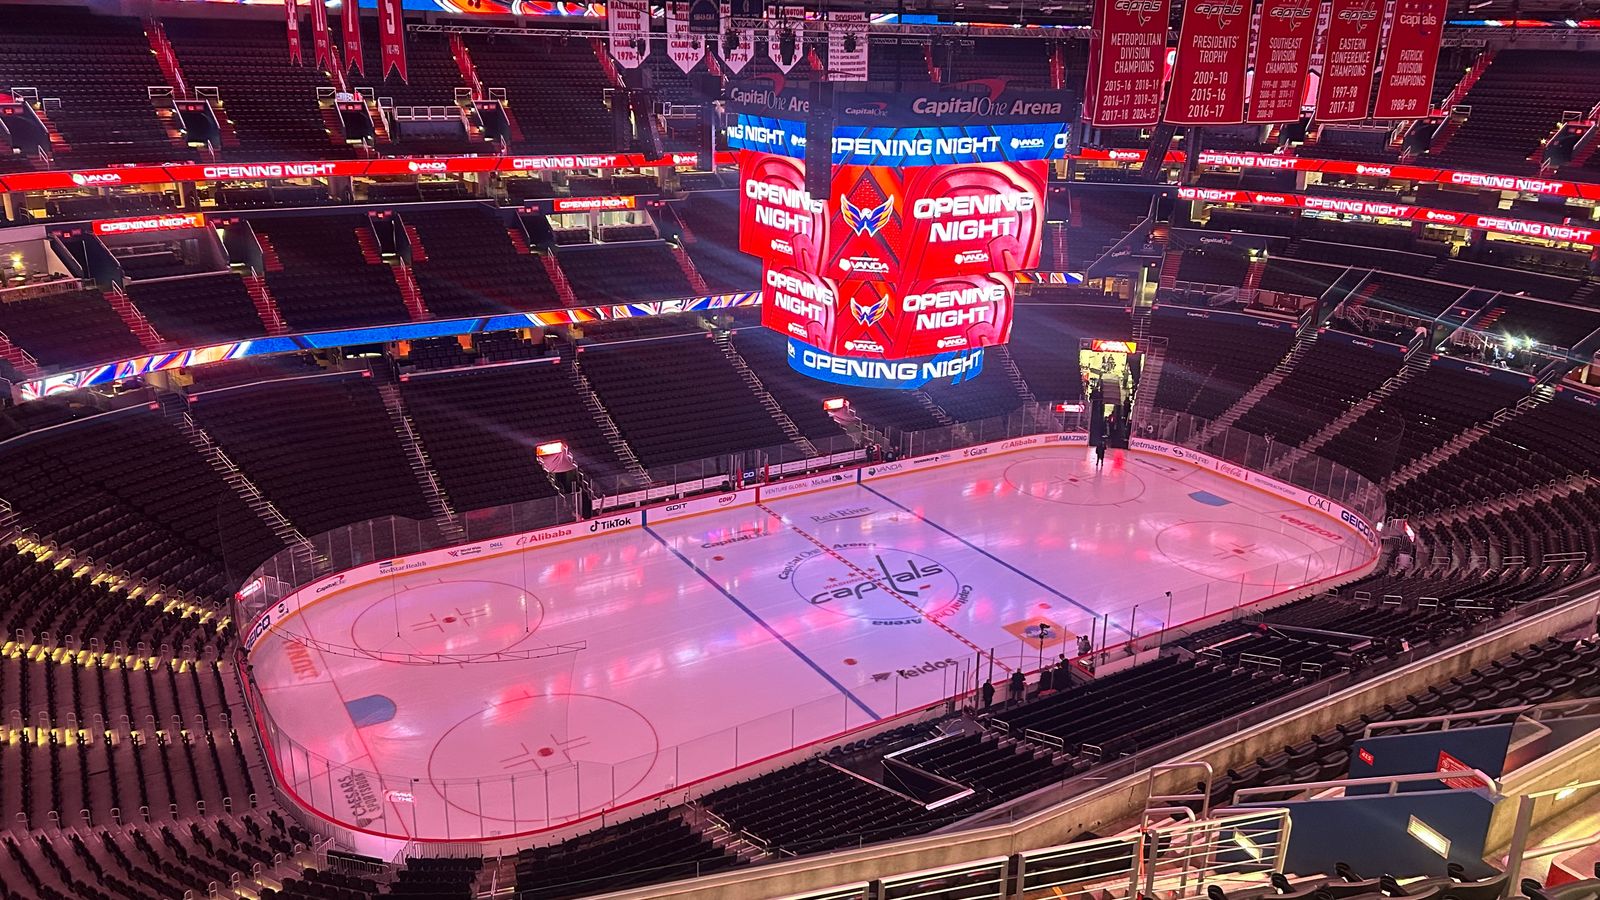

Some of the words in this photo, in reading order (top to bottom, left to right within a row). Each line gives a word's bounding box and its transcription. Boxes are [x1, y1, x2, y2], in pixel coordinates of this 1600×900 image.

[610, 2, 646, 10] BALTIMORE
[617, 11, 640, 19] BULLETS
[1111, 33, 1162, 46] METROPOLITAN
[1269, 37, 1303, 49] SOUTHEAST
[1339, 38, 1367, 50] EASTERN
[1120, 47, 1151, 59] DIVISION
[1199, 50, 1228, 63] TROPHY
[1271, 50, 1296, 61] DIVISION
[1330, 51, 1370, 64] CONFERENCE
[1399, 50, 1423, 61] PATRICK
[1114, 61, 1155, 73] CHAMPIONS
[1265, 62, 1298, 74] CHAMPIONS
[1330, 65, 1367, 77] CHAMPIONS
[1396, 63, 1423, 74] DIVISION
[1193, 72, 1228, 85] 2009-10
[1390, 75, 1426, 86] CHAMPIONS
[1104, 80, 1131, 91] 2015-16
[1135, 79, 1159, 90] 2018-19
[1190, 88, 1226, 101] 2015-16
[1332, 86, 1358, 98] 1997-98
[788, 96, 810, 113] Are
[1103, 94, 1130, 106] 2016-17
[1390, 99, 1417, 110] 1988-89
[1010, 100, 1061, 116] Arena
[1187, 105, 1225, 117] 2016-17
[1328, 101, 1355, 114] 2017-18
[1101, 109, 1129, 120] 2017-18
[744, 126, 785, 146] NIGHT
[936, 137, 1001, 154] NIGHT
[1020, 138, 1044, 147] VANDA
[417, 162, 447, 170] VANDA
[513, 158, 574, 168] OPENING
[576, 156, 616, 168] NIGHT
[1198, 153, 1254, 165] OPENING
[1256, 158, 1297, 168] NIGHT
[204, 166, 282, 178] OPENING
[285, 163, 336, 176] NIGHT
[84, 173, 121, 182] VANDA
[1452, 172, 1514, 188] OPENING
[1515, 179, 1563, 193] NIGHT
[745, 179, 823, 214] OPENING
[1197, 189, 1236, 200] NIGHT
[1262, 195, 1284, 203] VANDA
[559, 200, 599, 209] OPENING
[601, 198, 630, 208] NIGHT
[913, 192, 1034, 219] OPENING
[1304, 198, 1363, 212] OPENING
[1365, 204, 1408, 216] NIGHT
[755, 204, 811, 235] NIGHT
[1435, 213, 1456, 221] VANDA
[100, 219, 157, 232] OPENING
[158, 216, 197, 229] NIGHT
[929, 217, 1015, 242] NIGHT
[1477, 216, 1542, 235] OPENING
[1543, 226, 1591, 241] NIGHT
[962, 253, 989, 261] VANDA
[851, 261, 889, 270] VANDA
[766, 270, 834, 307] OPENING
[903, 285, 1005, 312] OPENING
[775, 291, 822, 321] NIGHT
[916, 306, 990, 331] NIGHT
[853, 343, 884, 351] VANDA
[944, 337, 967, 346] VANDA
[803, 350, 917, 380] OPENING
[922, 351, 982, 379] NIGHT
[1009, 437, 1037, 448] Alibaba
[969, 447, 988, 456] Giant
[875, 463, 903, 474] VANDA
[811, 477, 832, 487] Michael
[764, 486, 787, 495] VENTURE
[788, 482, 807, 490] GLOBAL
[718, 495, 733, 503] CDW
[1307, 494, 1332, 512] CACI
[665, 502, 687, 511] GDIT
[810, 512, 838, 523] Red
[839, 505, 873, 518] River
[601, 517, 631, 529] TikTok
[1280, 514, 1343, 541] verizon
[1340, 510, 1370, 537] GEICO
[529, 528, 572, 543] Alibaba
[379, 565, 405, 576] MedStar
[405, 560, 427, 571] Health
[810, 554, 943, 605] capitals
[871, 617, 922, 626] Arena
[1361, 752, 1372, 761] 415
[338, 774, 366, 817] CAESARS
